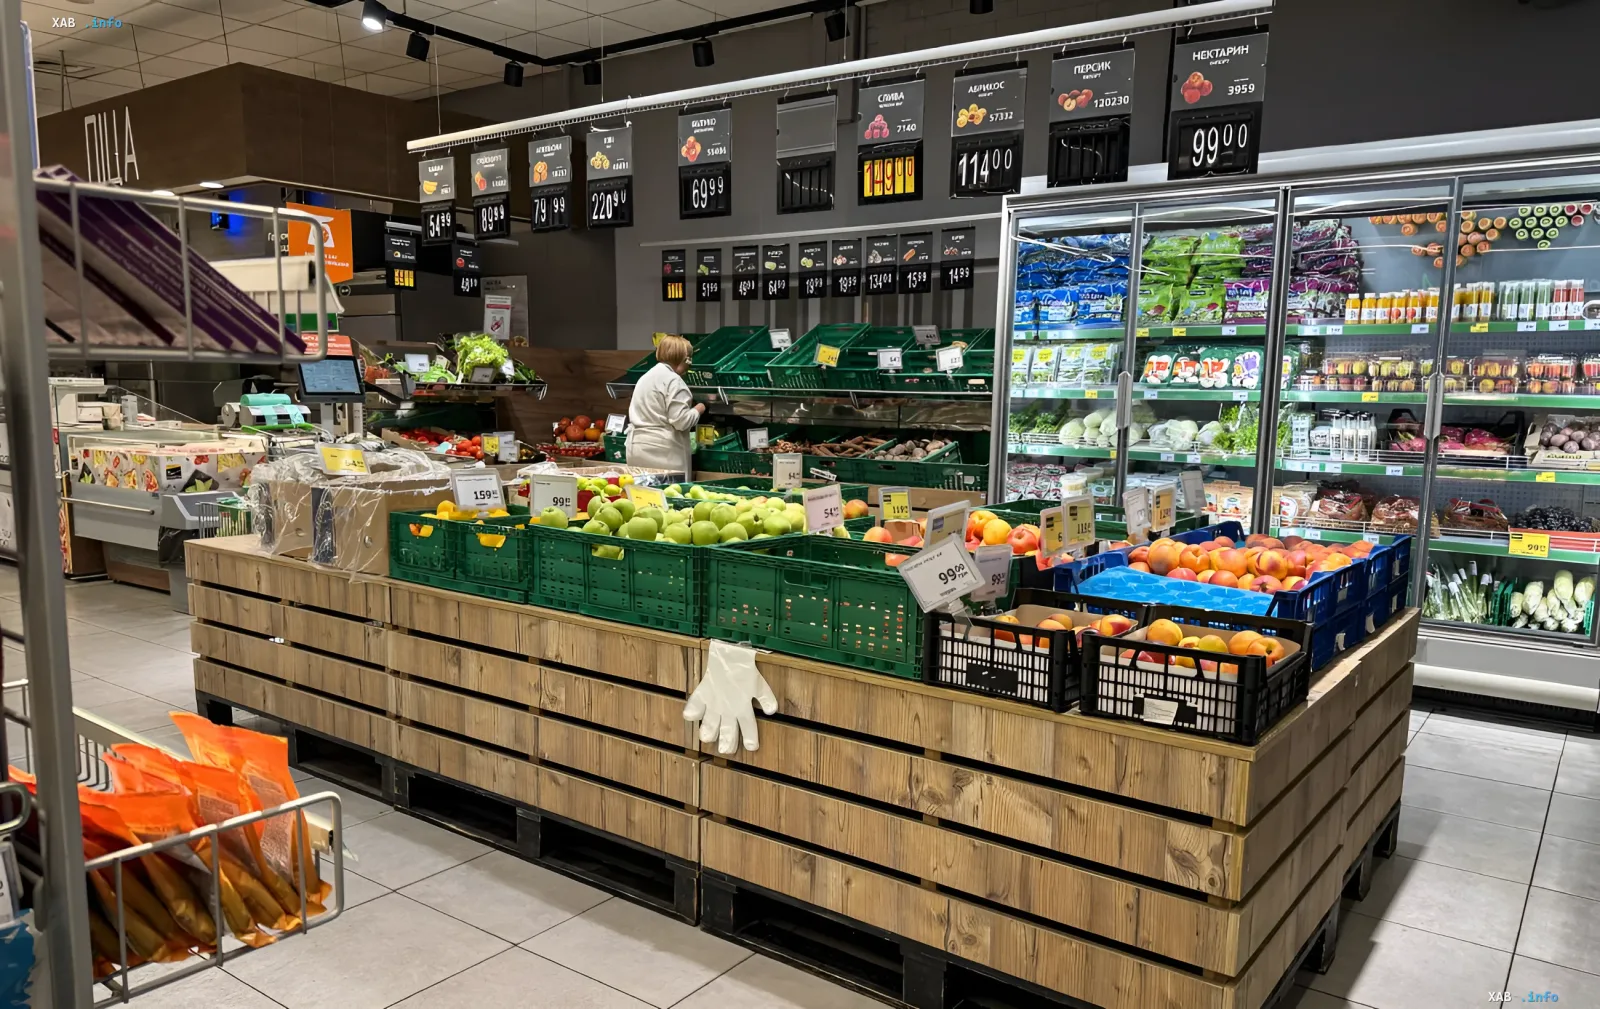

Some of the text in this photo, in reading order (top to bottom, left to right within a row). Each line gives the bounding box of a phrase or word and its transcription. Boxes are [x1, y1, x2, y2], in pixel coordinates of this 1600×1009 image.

[1192, 45, 1249, 60] НЕКТАРИН
[1074, 60, 1111, 74] ПЕРСИК
[1228, 84, 1255, 95] 3959
[1094, 96, 1129, 108] 120230
